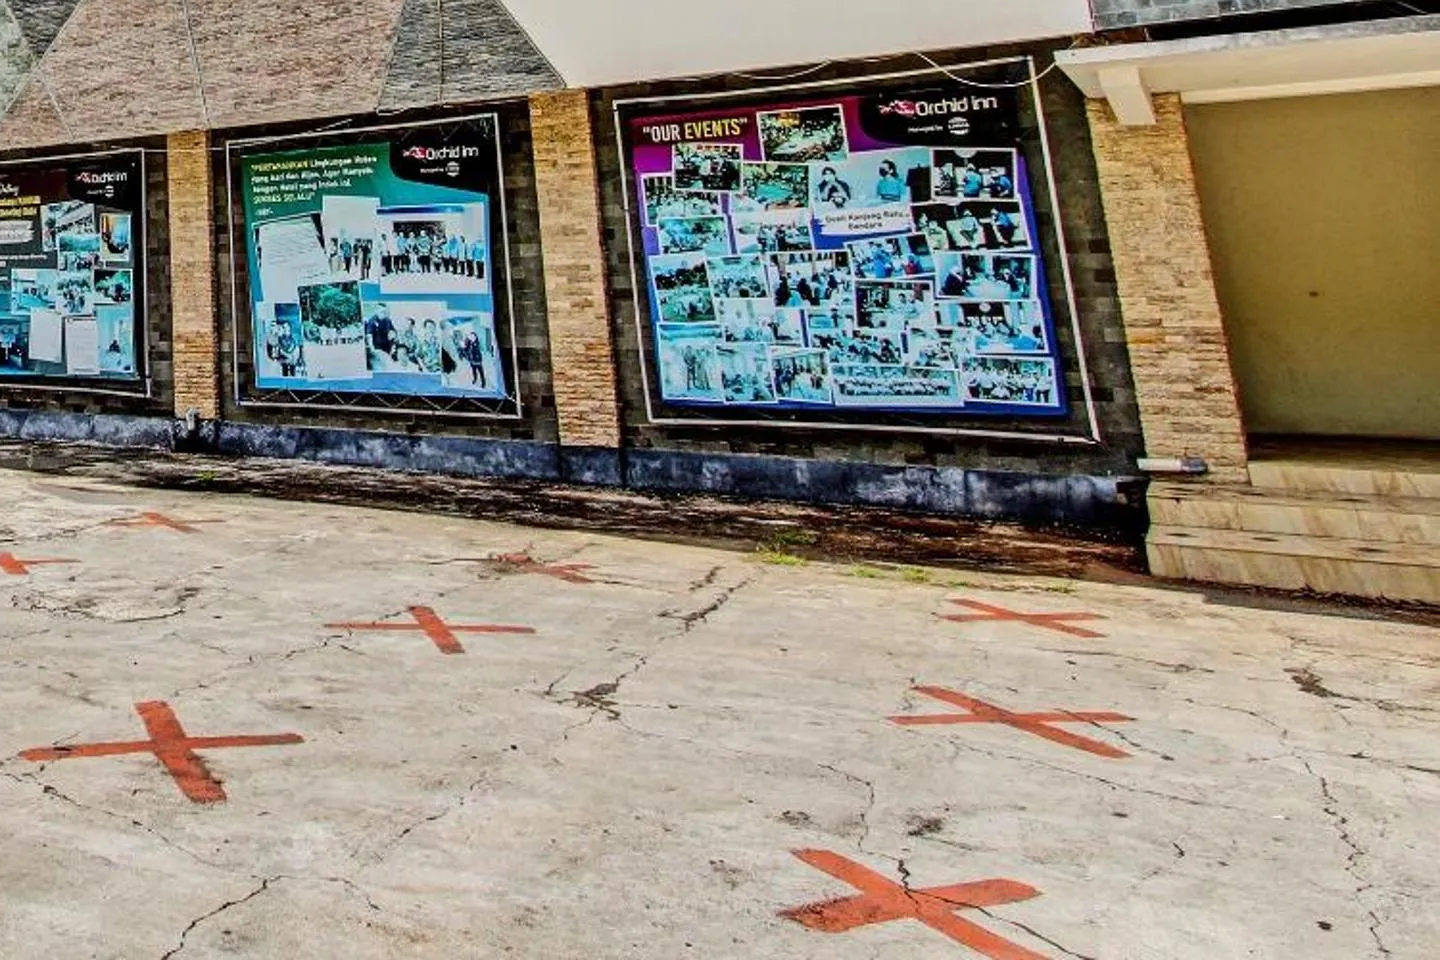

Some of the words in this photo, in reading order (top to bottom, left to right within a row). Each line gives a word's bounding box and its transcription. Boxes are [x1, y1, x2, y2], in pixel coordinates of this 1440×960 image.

[915, 96, 968, 116] Orchid
[643, 123, 681, 142] "OUR
[684, 117, 748, 139] EVENTS"
[426, 145, 460, 160] Orchid
